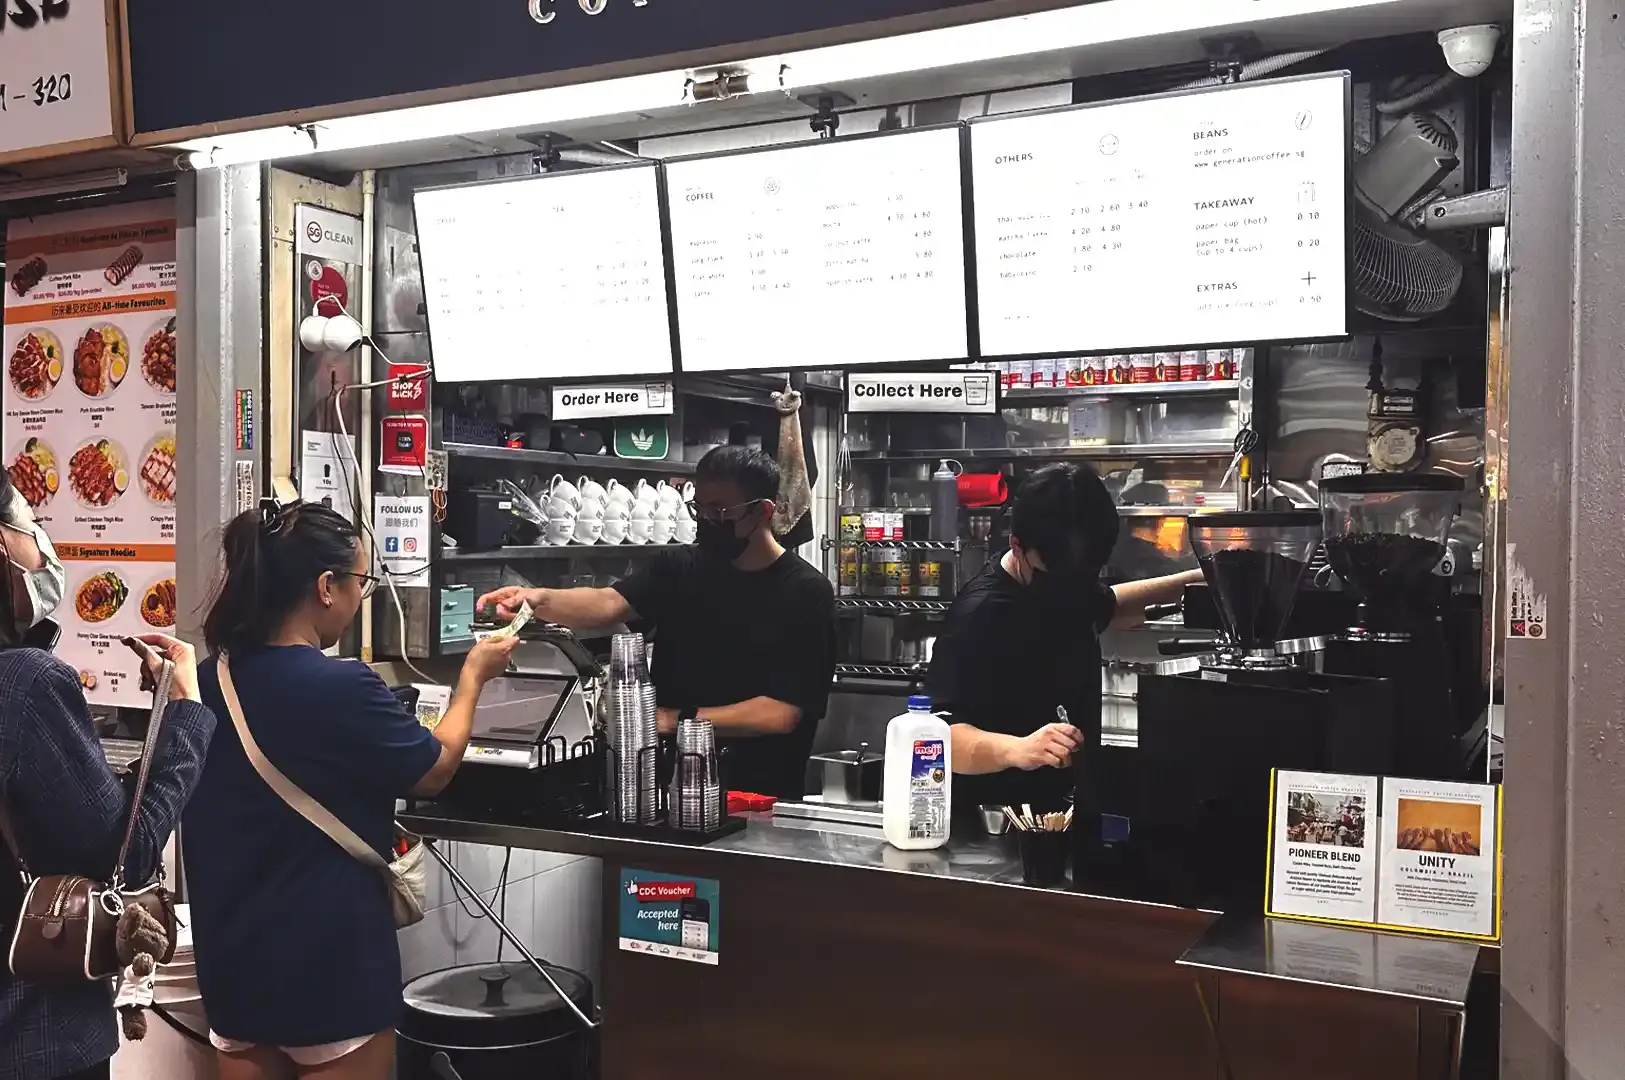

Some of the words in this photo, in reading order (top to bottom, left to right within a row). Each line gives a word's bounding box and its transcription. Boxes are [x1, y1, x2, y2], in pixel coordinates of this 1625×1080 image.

[1193, 128, 1229, 140] BEANS
[995, 152, 1034, 164] OTHERS
[1194, 149, 1217, 157] order
[1194, 150, 1306, 168] wwwgenerationcoffeesg
[685, 192, 714, 201] COFFEE
[1071, 206, 1090, 216] 210
[1100, 204, 1120, 213] 260
[1129, 200, 1148, 209] 340
[1194, 196, 1255, 210] TAKEAWAY
[1297, 211, 1320, 221] 010
[1195, 222, 1219, 231] paper
[1243, 216, 1268, 226] (hot)
[309, 227, 321, 238] SG
[324, 230, 354, 245] CLEAN
[914, 230, 932, 238] 480
[1071, 227, 1091, 236] 420
[1101, 224, 1121, 232] 480
[1073, 244, 1092, 252] 380
[1103, 242, 1122, 250] 430
[1297, 238, 1320, 248] 020
[915, 251, 933, 259] 580
[1073, 264, 1092, 273] 210
[1196, 281, 1238, 293] EXTRAS
[102, 300, 129, 311] All-time
[130, 297, 166, 309] Favourites
[1299, 295, 1322, 304] 050
[391, 382, 413, 390] SHOP
[854, 383, 914, 397] Collect
[920, 384, 963, 397] Here
[391, 390, 413, 398] BACK
[561, 393, 600, 406] Order
[604, 392, 639, 403] Here
[381, 505, 411, 514] FOLLOW
[79, 547, 109, 558] Signature
[110, 548, 136, 557] Noodles
[915, 744, 942, 757] meiji
[1288, 847, 1328, 860] PIONEER
[1330, 852, 1361, 863] BLEND
[1418, 855, 1456, 869] UNITY
[1400, 866, 1437, 875] COLOMBIA
[1448, 871, 1474, 879] BRAZIL
[639, 888, 656, 896] CDC
[658, 886, 691, 895] Voucher
[637, 908, 679, 920] Accepted
[657, 920, 679, 931] here
